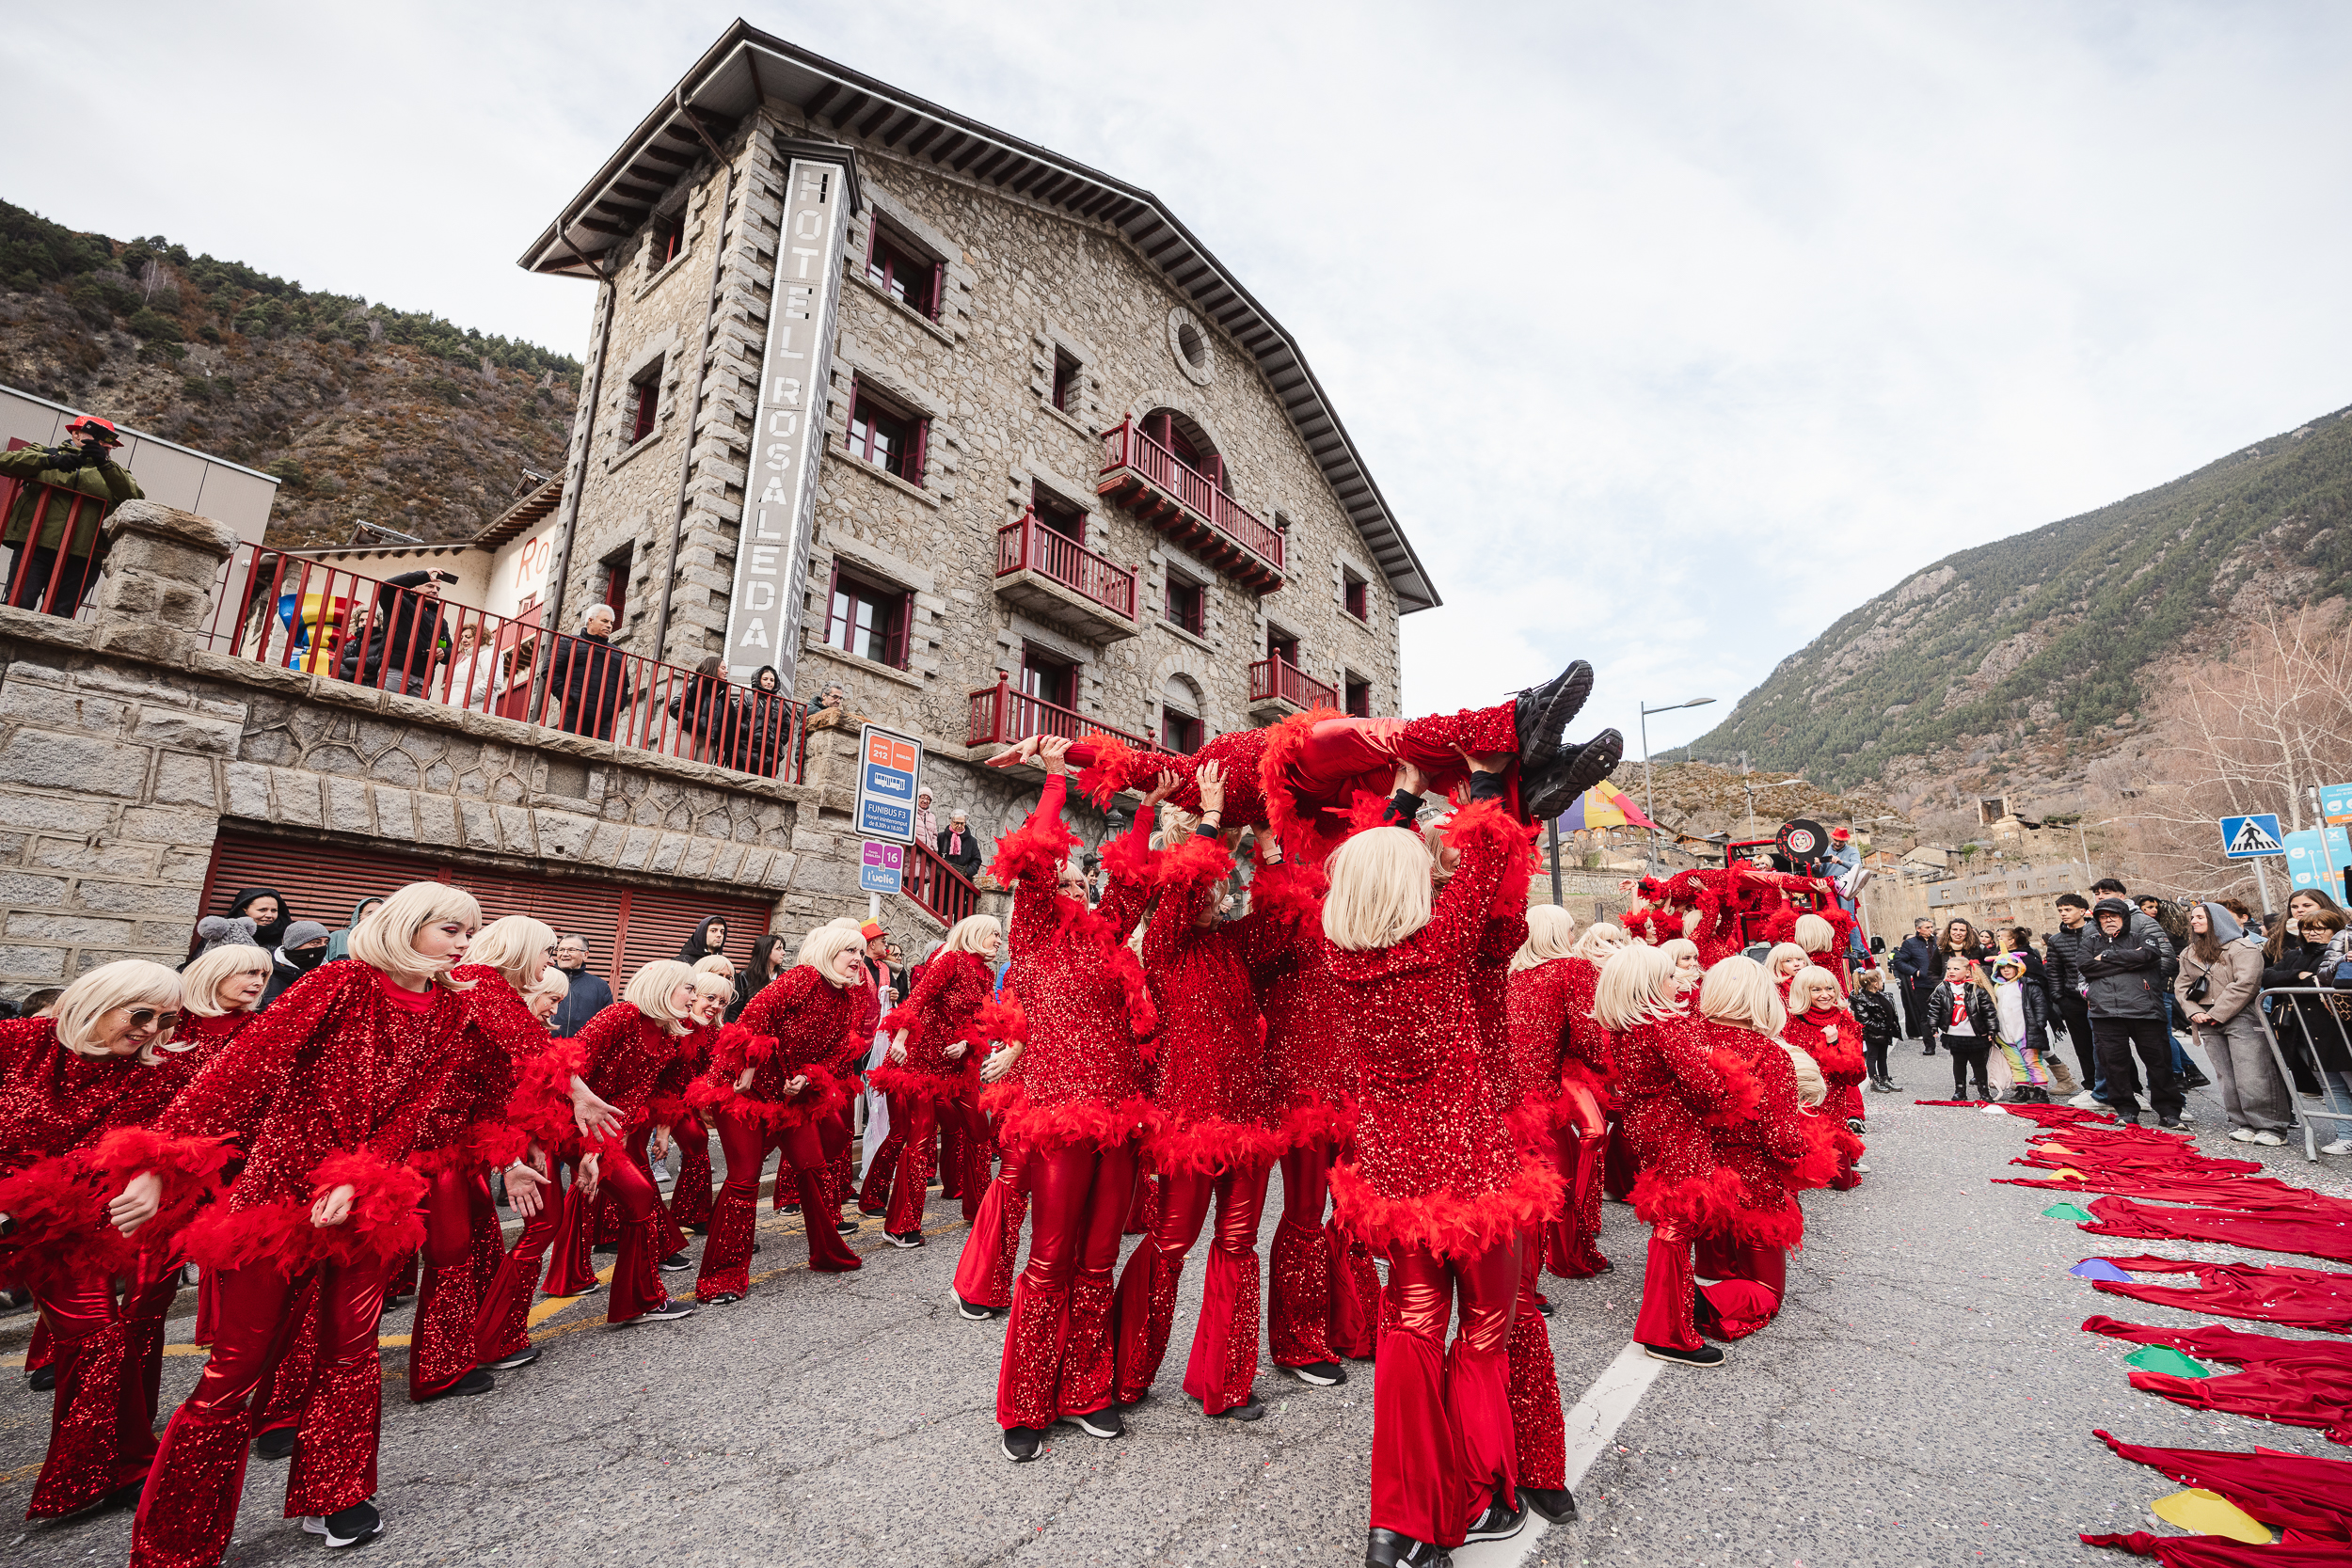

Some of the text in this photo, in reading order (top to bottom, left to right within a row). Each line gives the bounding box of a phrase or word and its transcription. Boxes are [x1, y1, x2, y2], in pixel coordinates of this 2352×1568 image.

[739, 170, 829, 649] HOTEL ROSALEDA
[873, 750, 888, 760] 212
[866, 813, 880, 821] Horari
[867, 803, 906, 819] FUNIBUS F3
[887, 851, 898, 863] 16
[867, 870, 895, 884] l'uclic
